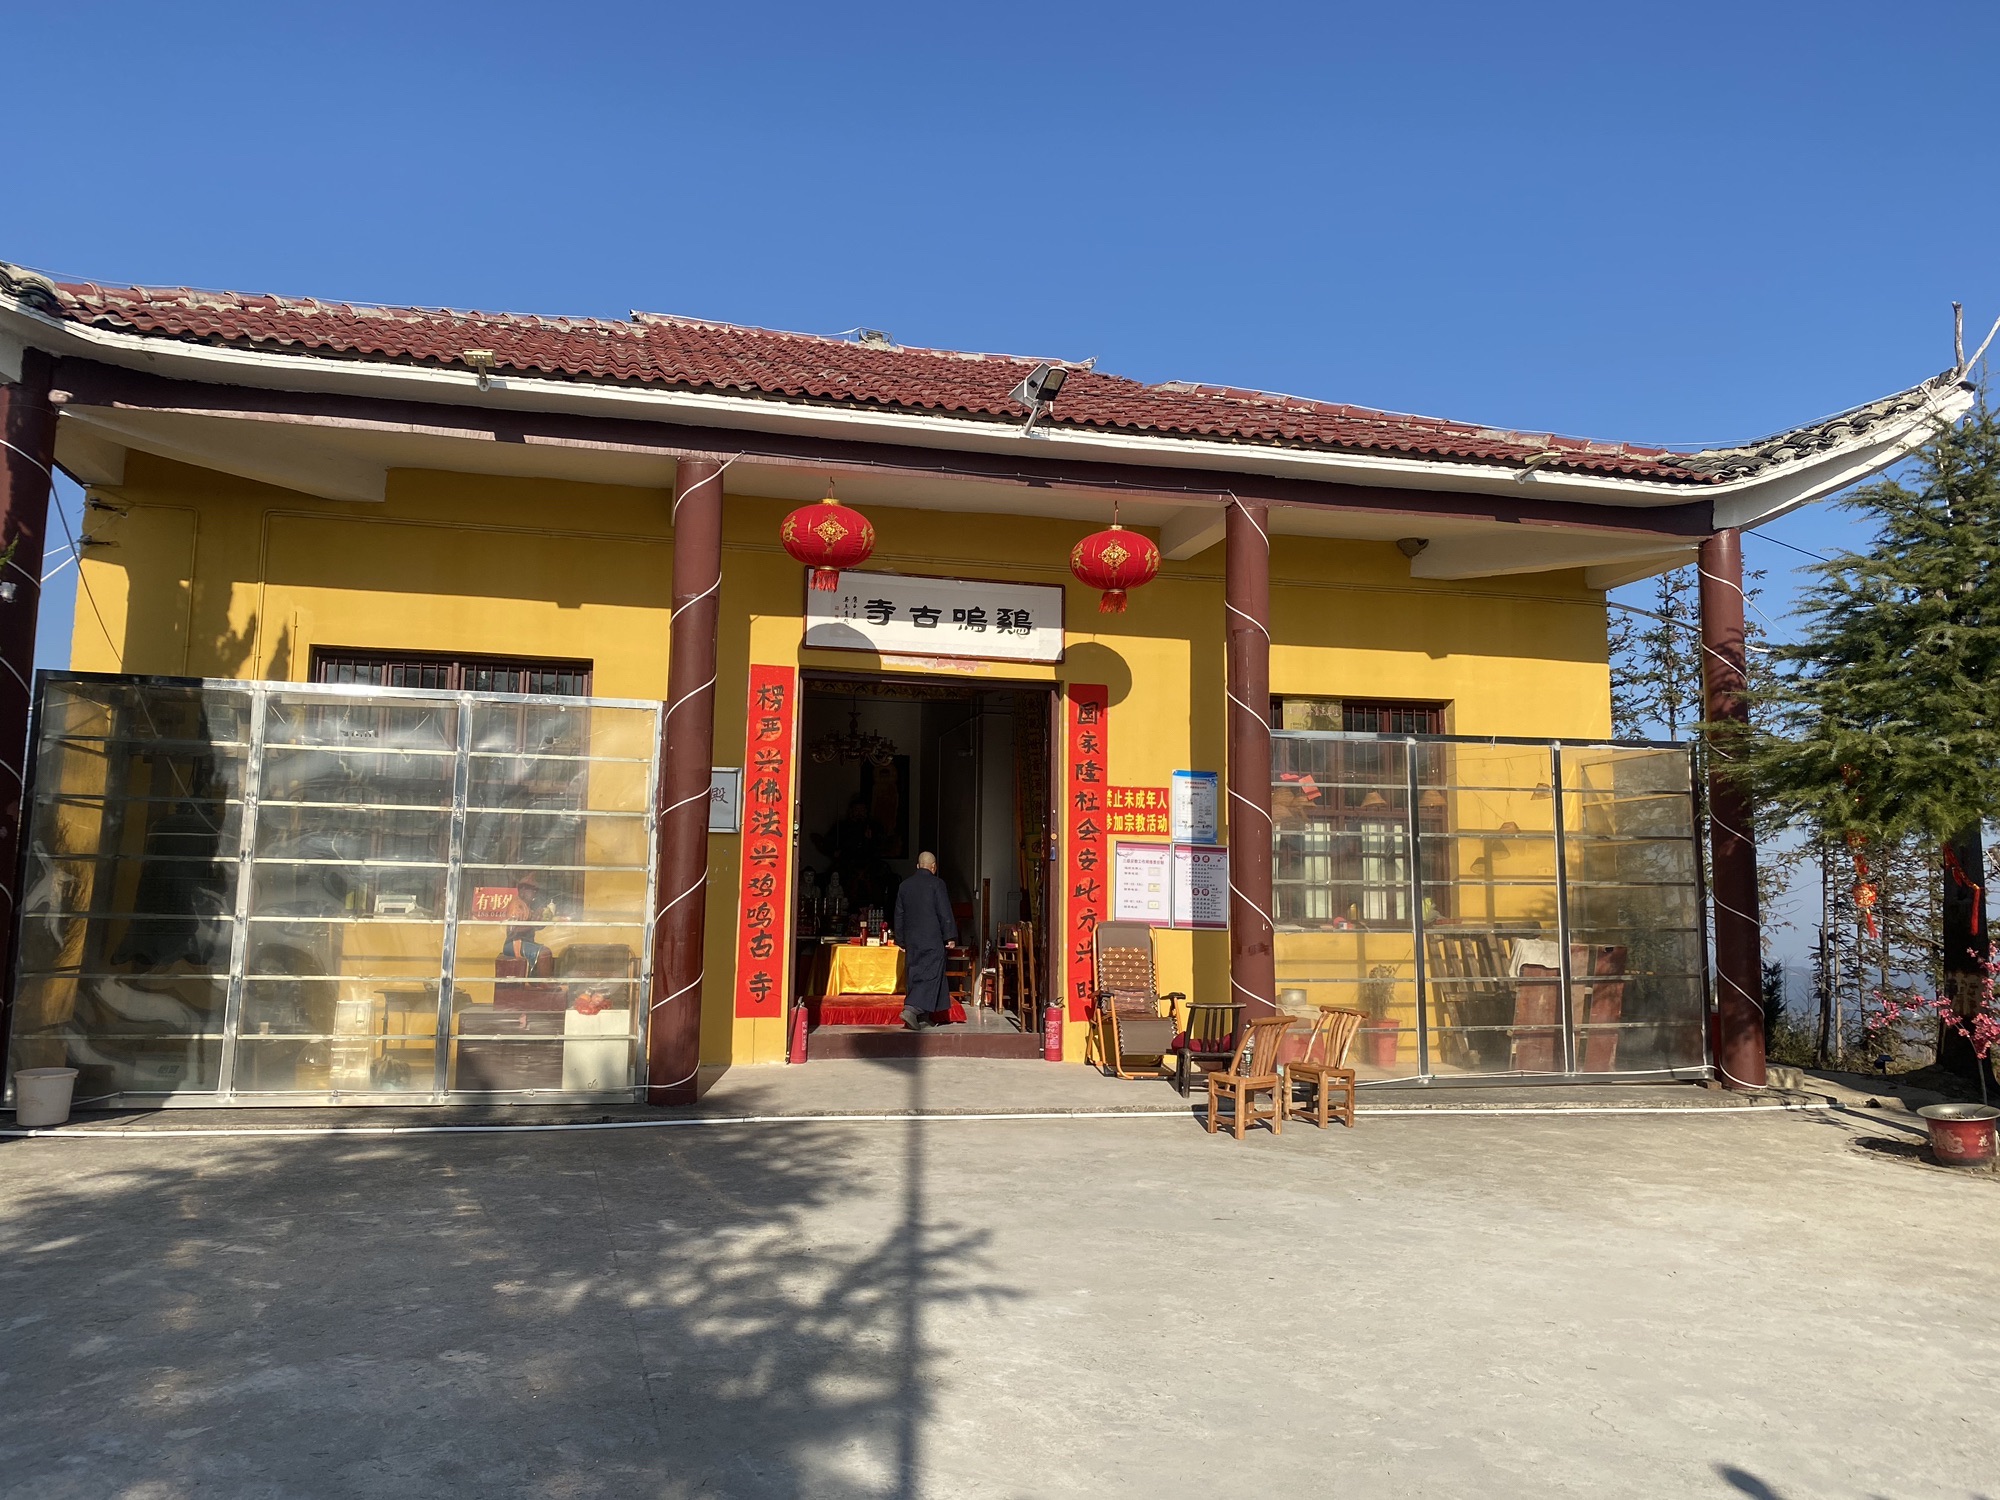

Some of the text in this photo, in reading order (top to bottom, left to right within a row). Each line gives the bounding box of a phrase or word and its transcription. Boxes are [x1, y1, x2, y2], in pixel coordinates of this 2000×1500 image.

[711, 787, 729, 804] 殿
[746, 683, 785, 1004] 楞严兴佛法兴鸡鸣古寺
